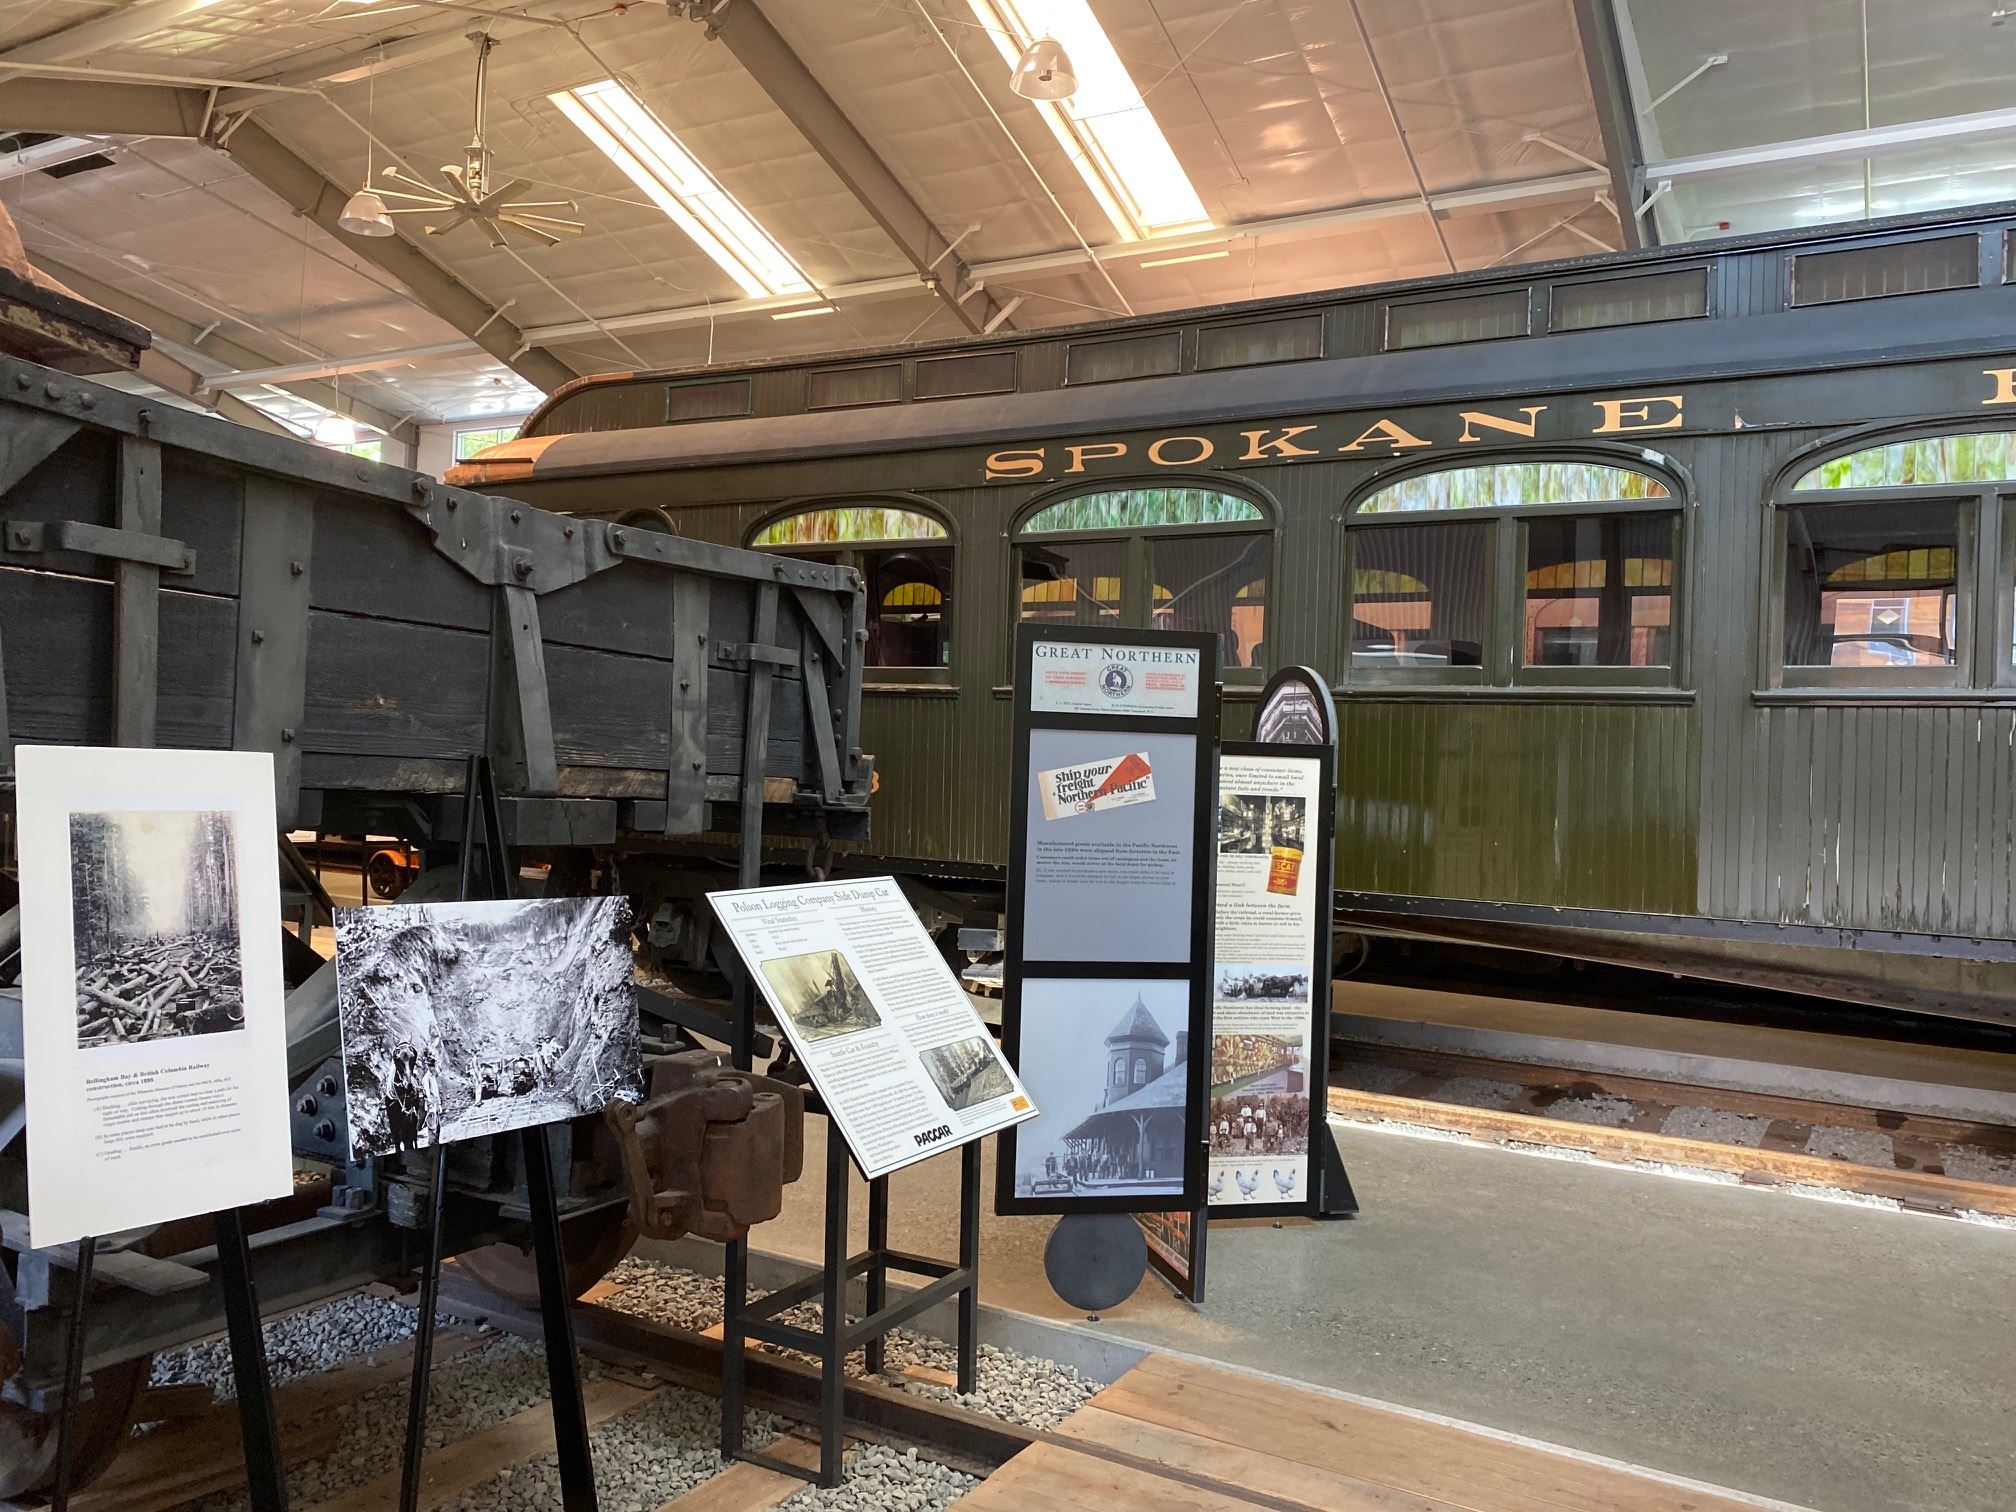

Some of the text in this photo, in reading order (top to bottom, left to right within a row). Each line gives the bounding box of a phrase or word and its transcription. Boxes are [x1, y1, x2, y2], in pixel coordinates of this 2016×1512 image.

[986, 395, 1684, 480] SPOKANE
[1035, 645, 1198, 665] GREAT NORTHERN
[1106, 664, 1128, 673] GREAT
[1100, 684, 1131, 698] NORTHERN
[1055, 764, 1112, 784] Ship your
[1056, 778, 1095, 794] freight
[1057, 786, 1107, 805] Northern
[1109, 778, 1147, 795] Pacific
[731, 887, 890, 914] Polson Logging Company Side Dump Car
[86, 1075, 118, 1085] Bellingham
[160, 1065, 187, 1073] Columbia
[188, 1062, 209, 1070] Railway
[86, 1082, 123, 1092] construction,
[913, 1124, 953, 1147] PACCAR
